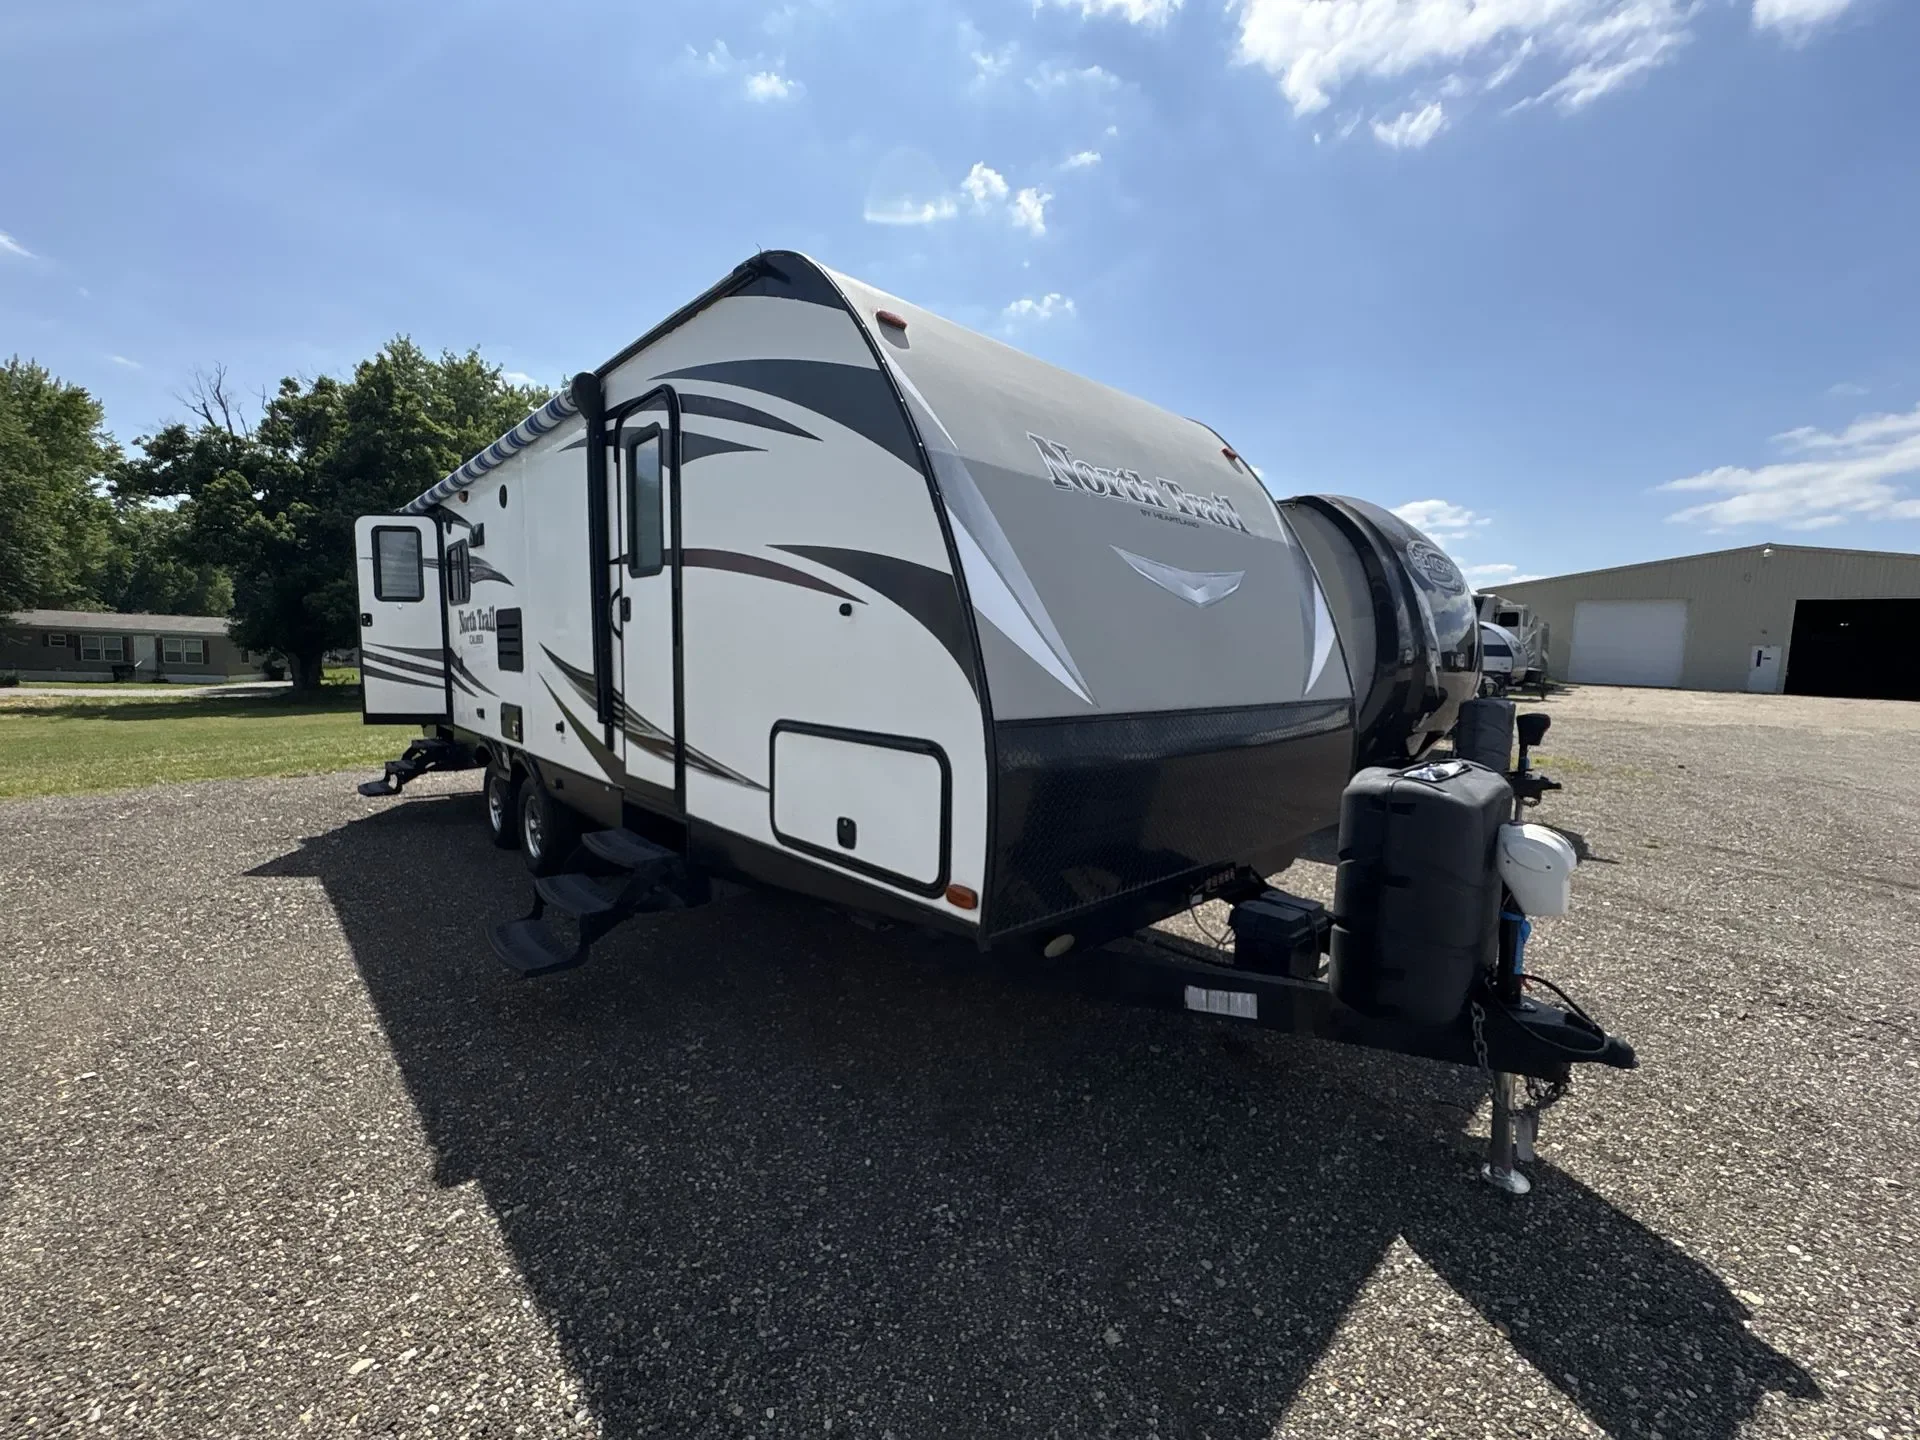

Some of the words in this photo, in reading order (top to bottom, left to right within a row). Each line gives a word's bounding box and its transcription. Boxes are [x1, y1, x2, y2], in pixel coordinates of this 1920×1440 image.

[1026, 430, 1168, 509] North
[1156, 477, 1252, 536] Trail
[458, 609, 477, 634] North
[476, 604, 496, 632] Trail
